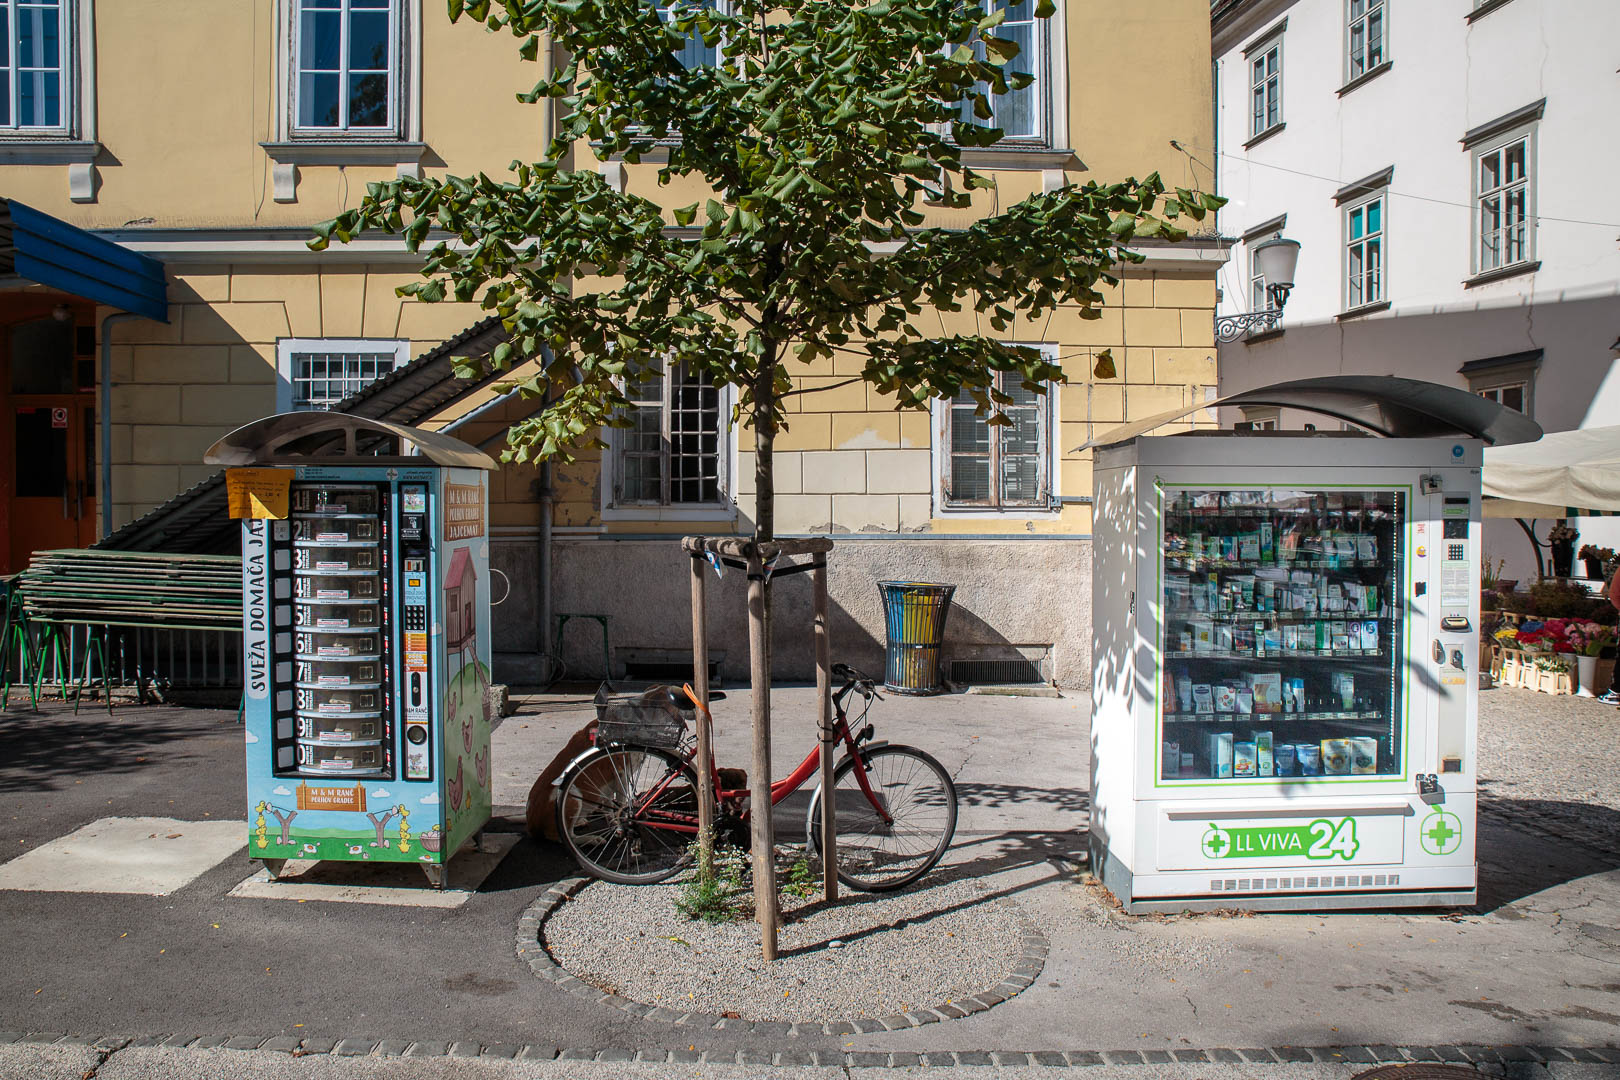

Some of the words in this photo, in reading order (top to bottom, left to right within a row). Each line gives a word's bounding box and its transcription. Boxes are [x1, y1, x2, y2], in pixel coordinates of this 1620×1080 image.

[293, 490, 303, 510] 1
[293, 520, 303, 541] 2
[449, 524, 479, 539] JAJCEMAT
[294, 549, 303, 569] 3
[246, 554, 265, 632] DOMAČA
[294, 577, 304, 598] 4
[294, 605, 304, 625] 5
[295, 633, 305, 653] 6
[247, 639, 266, 692] SVEŽA
[295, 661, 305, 682] 7
[296, 689, 306, 710] 8
[296, 717, 306, 737] 9
[296, 745, 306, 765] 0
[311, 788, 318, 796] M
[336, 788, 354, 797] RANČ
[1236, 834, 1254, 852] LL
[1258, 832, 1302, 851] VIVA
[1307, 817, 1359, 860] 24
